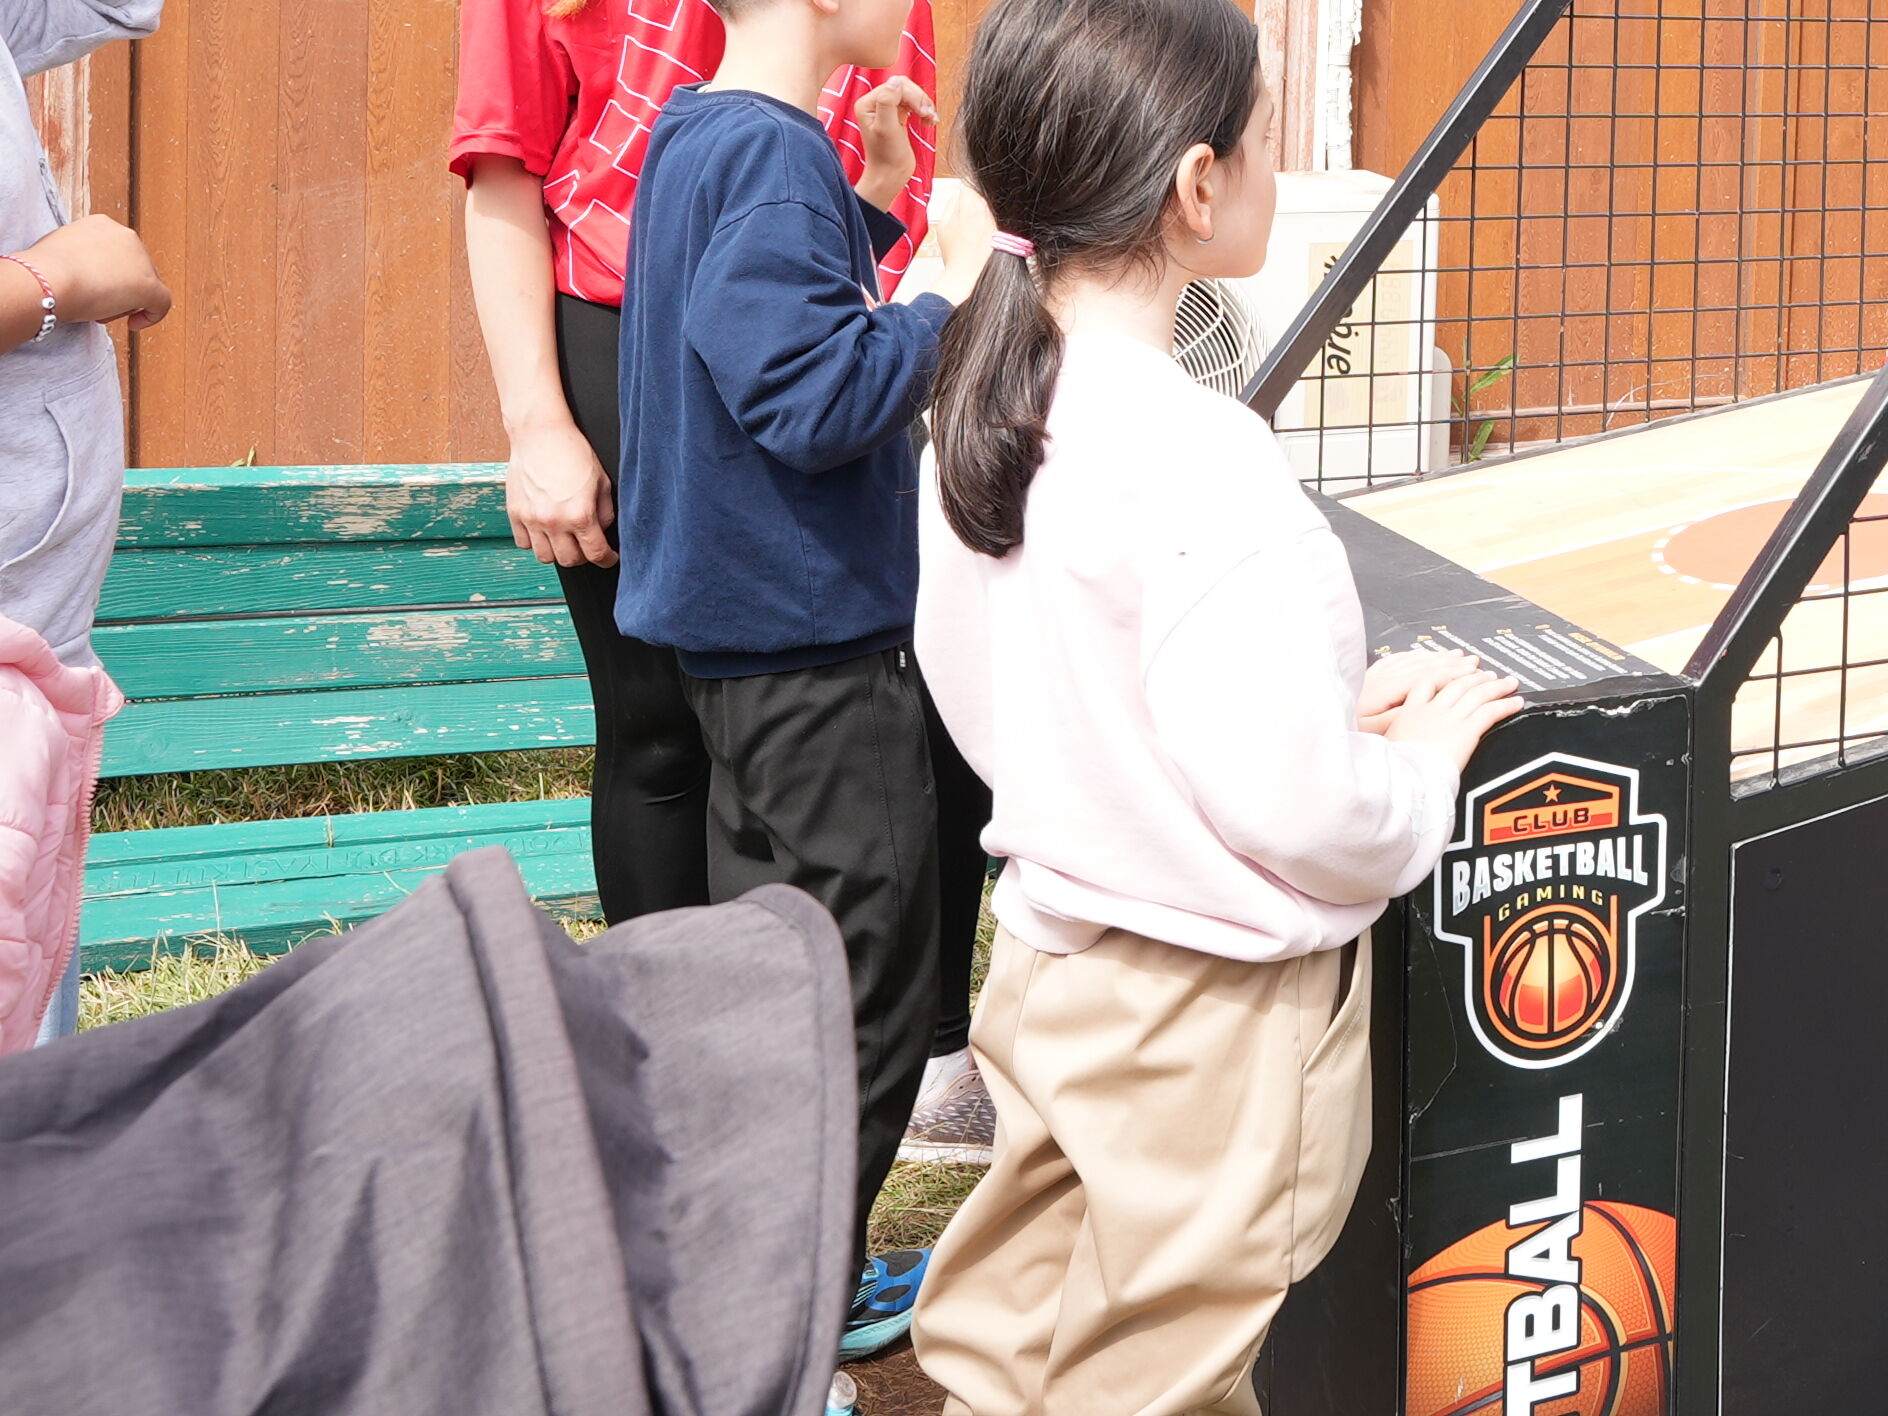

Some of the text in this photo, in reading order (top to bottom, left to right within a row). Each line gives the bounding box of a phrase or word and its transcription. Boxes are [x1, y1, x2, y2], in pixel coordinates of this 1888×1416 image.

[1512, 807, 1590, 834] CLUB
[1452, 834, 1649, 917] BASKETBALL
[1498, 884, 1604, 922] GAMING
[1506, 1093, 1583, 1416] TBALL
